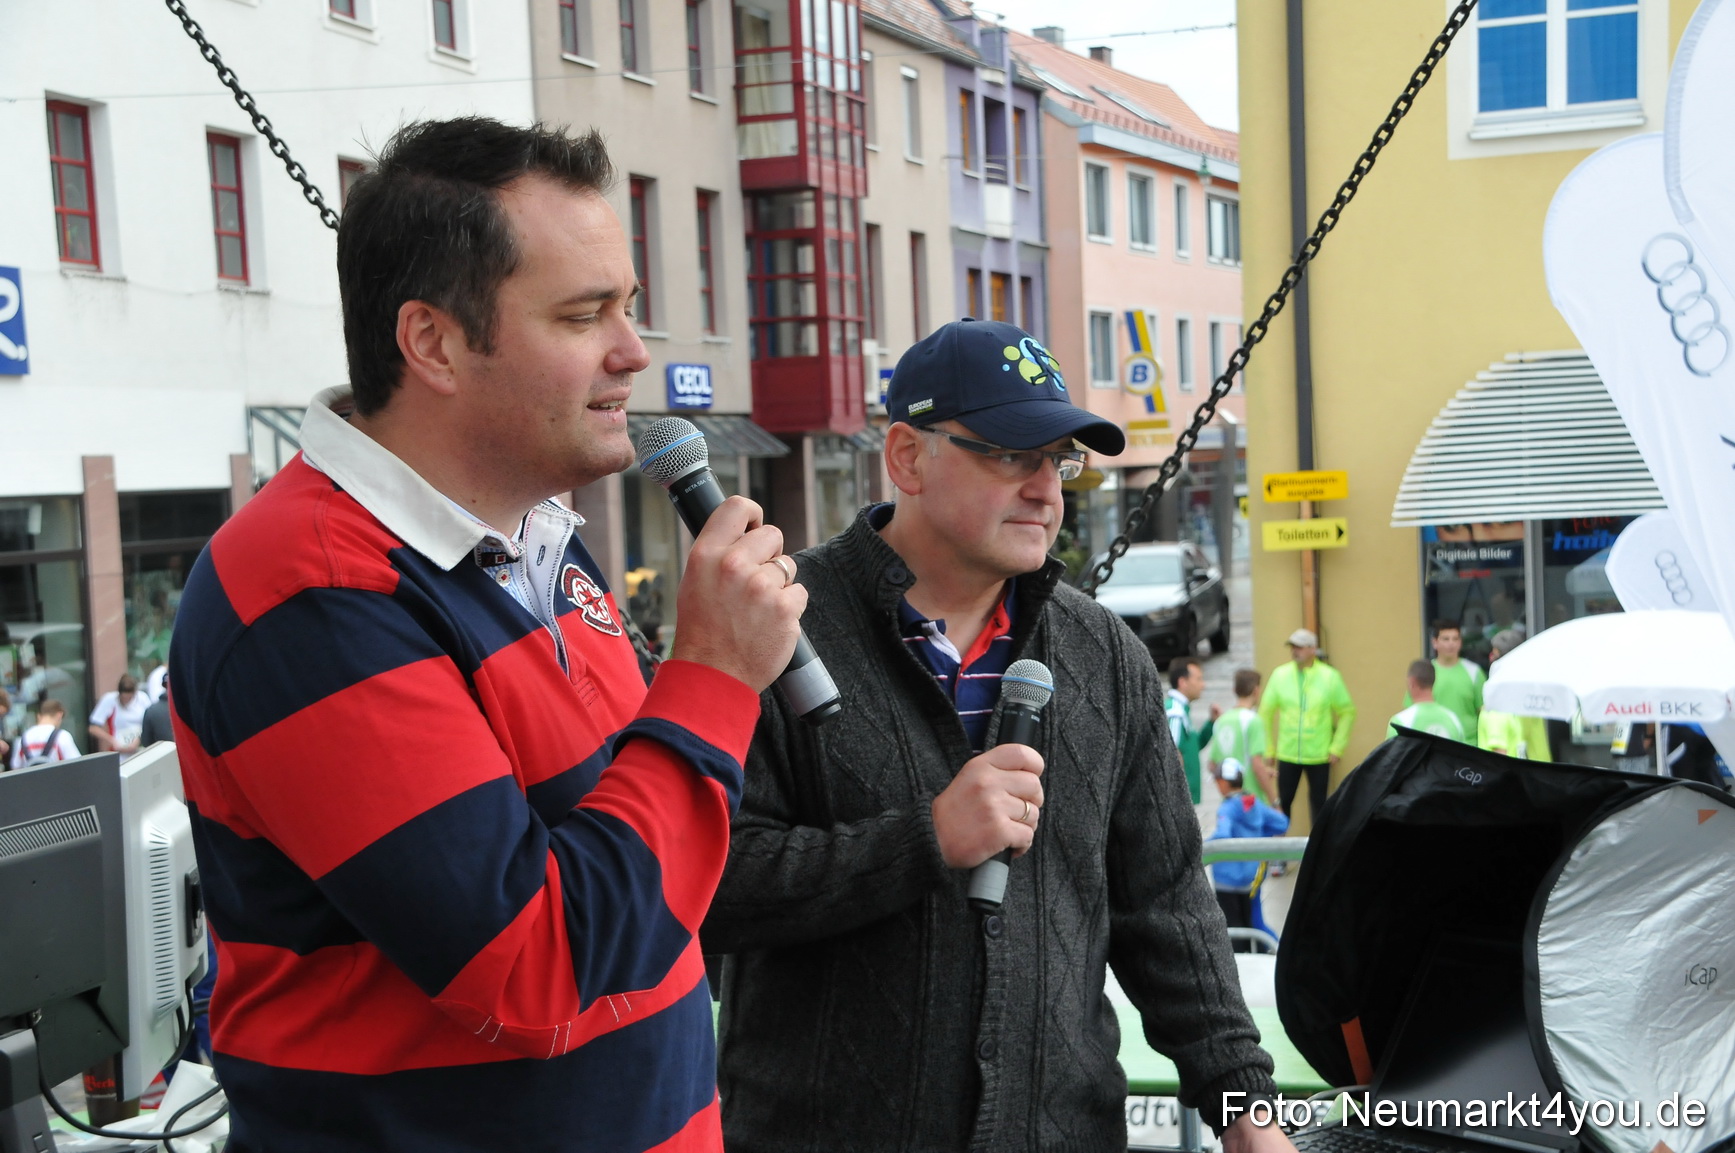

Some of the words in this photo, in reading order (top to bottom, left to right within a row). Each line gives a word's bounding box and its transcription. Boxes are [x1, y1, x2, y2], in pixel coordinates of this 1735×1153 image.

[1277, 528, 1330, 541] Toiletten
[1436, 549, 1477, 564] Digitale
[1479, 547, 1513, 560] Bilder
[1604, 702, 1652, 715] Audi
[1660, 702, 1703, 715] BKK
[1454, 766, 1483, 786] iCap
[1684, 963, 1718, 990] iCap
